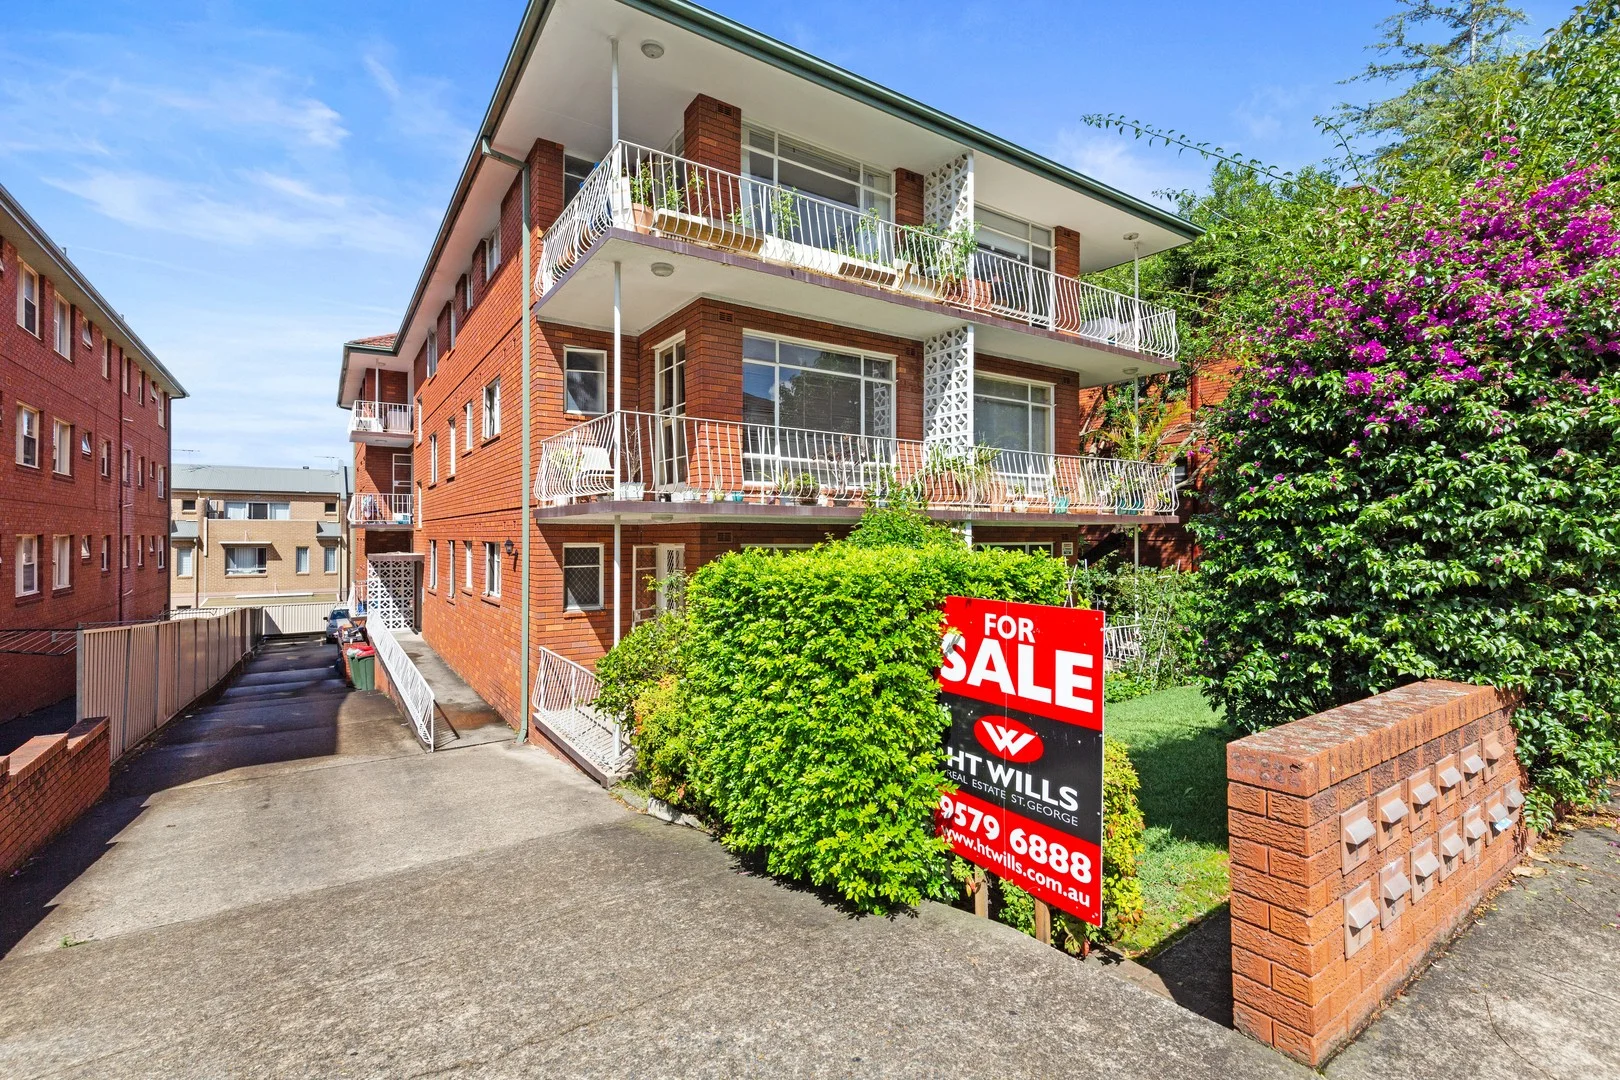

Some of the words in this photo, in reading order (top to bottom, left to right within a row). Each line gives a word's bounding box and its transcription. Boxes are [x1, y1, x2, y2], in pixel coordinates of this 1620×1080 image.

[984, 612, 1036, 643] FOR
[940, 632, 1094, 714] SALE
[946, 769, 968, 785] REAL
[972, 778, 1007, 800] ESTATE
[947, 746, 983, 776] HT
[986, 759, 1079, 812] WILLS
[939, 795, 1000, 840] 9579
[1009, 828, 1092, 884] 6888
